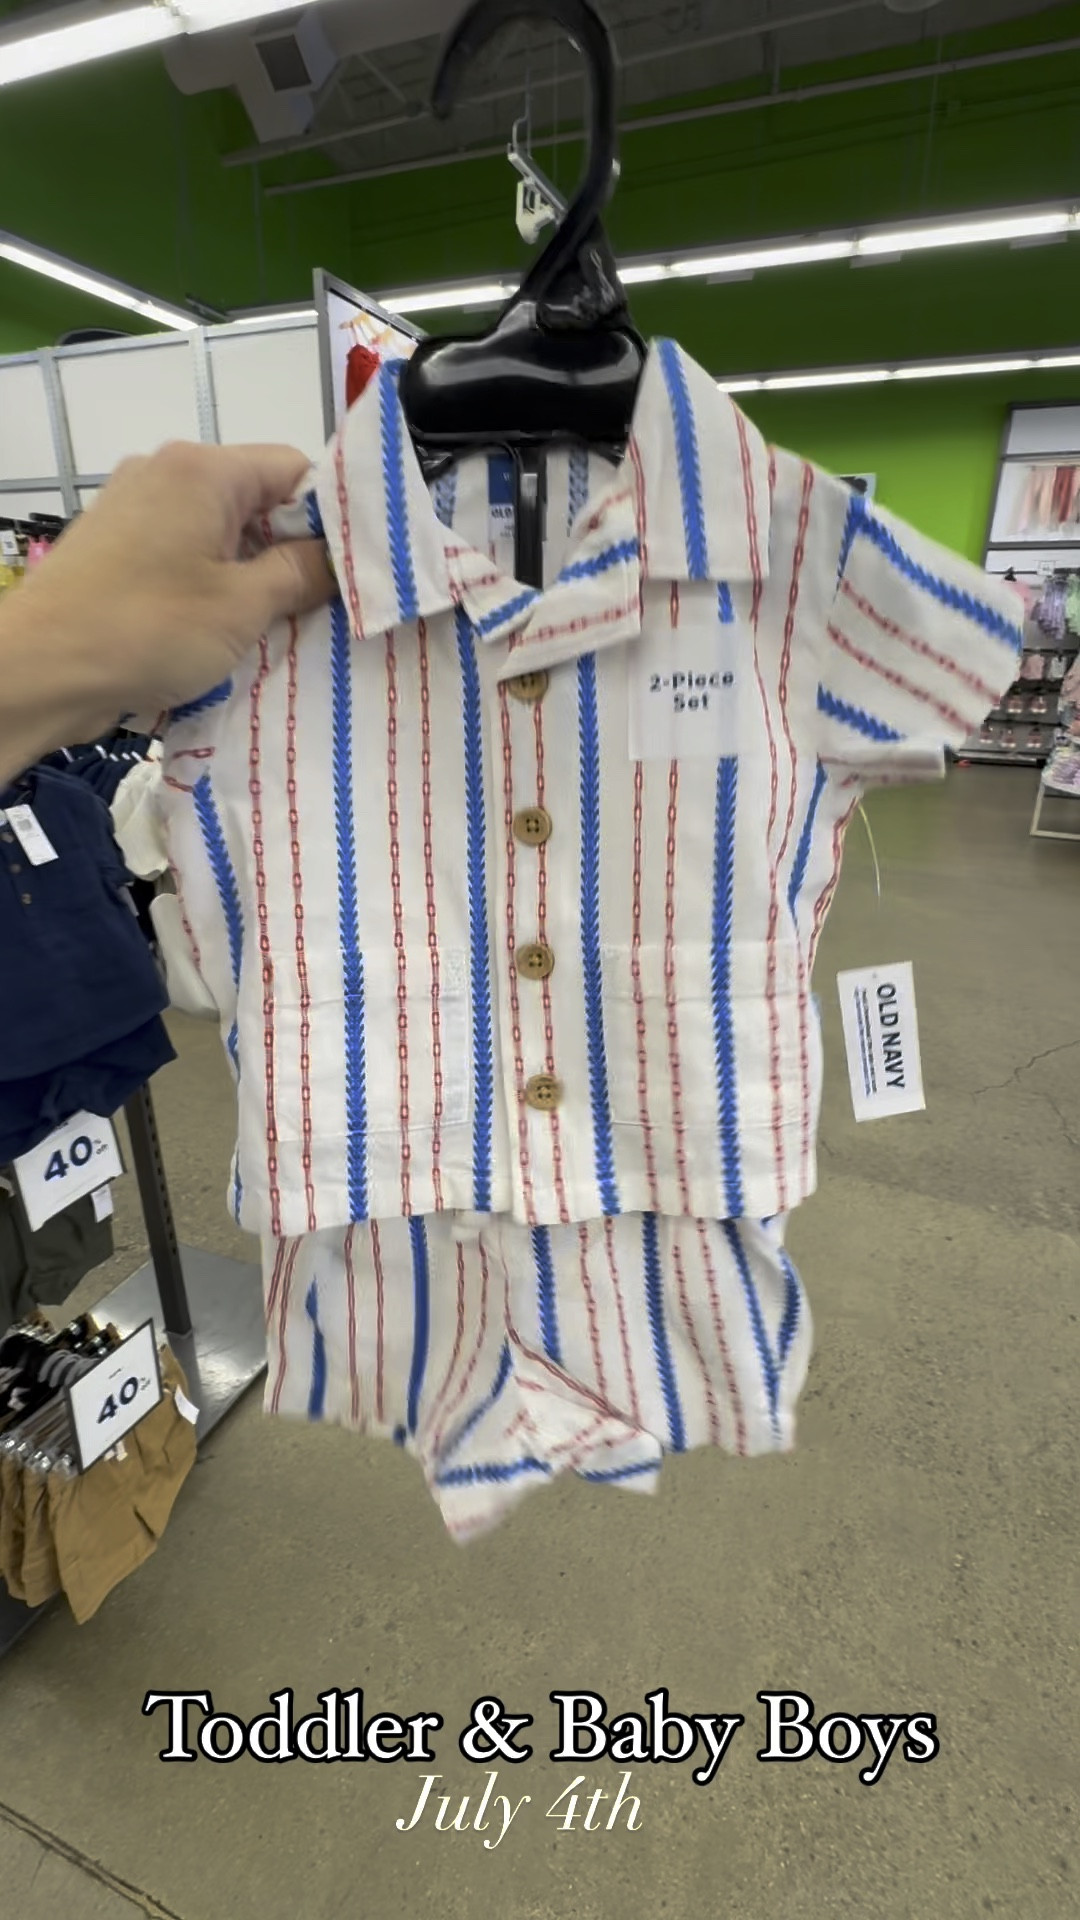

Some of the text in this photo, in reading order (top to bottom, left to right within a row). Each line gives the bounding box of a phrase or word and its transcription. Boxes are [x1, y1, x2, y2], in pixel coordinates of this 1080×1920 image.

[649, 670, 734, 693] 2-Piece
[673, 692, 709, 713] Set
[876, 983, 906, 1089] OLD NAVY
[44, 1135, 93, 1182] 40
[97, 1376, 139, 1425] 40
